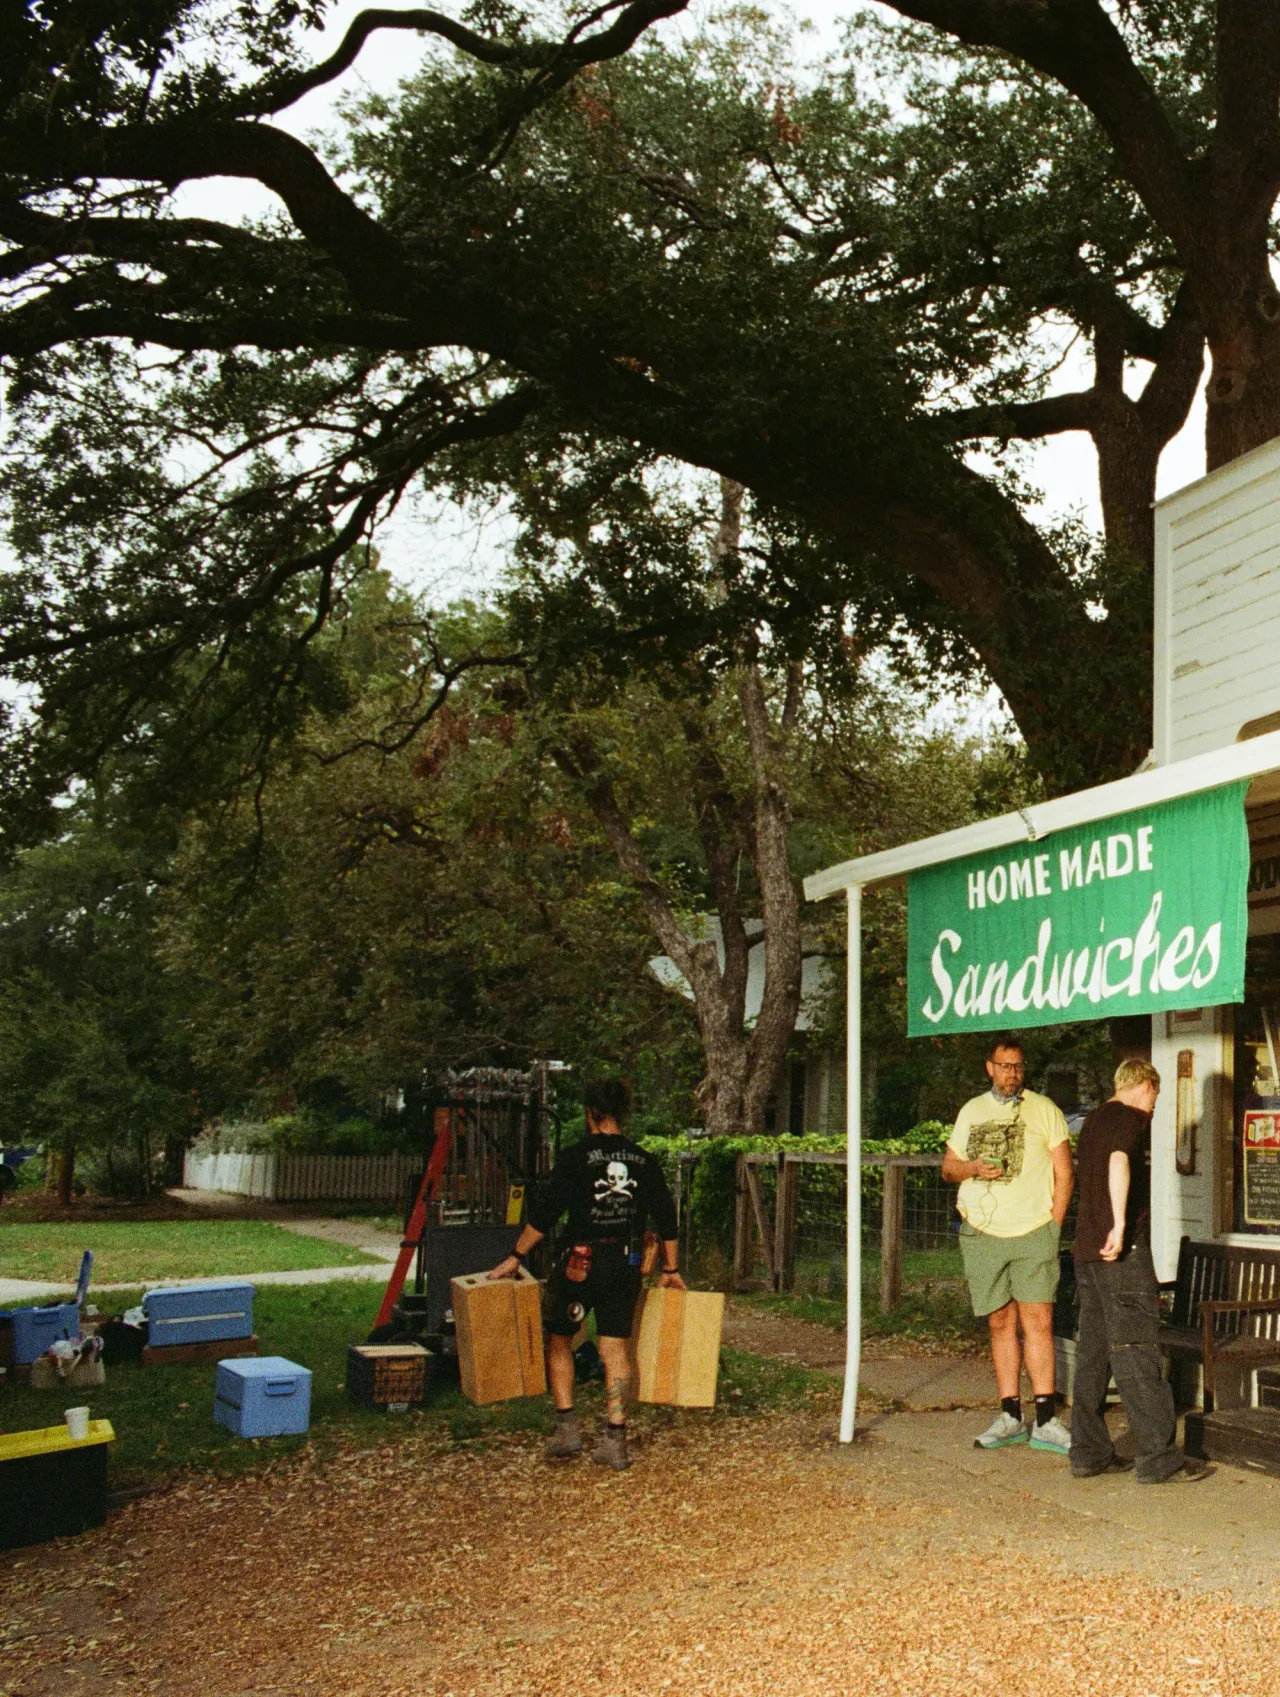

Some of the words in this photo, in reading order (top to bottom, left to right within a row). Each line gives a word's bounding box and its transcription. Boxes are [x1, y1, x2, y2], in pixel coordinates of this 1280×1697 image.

[968, 854, 1052, 910] HOME
[1059, 825, 1153, 891] MADE
[922, 891, 1221, 1023] Sandwiches
